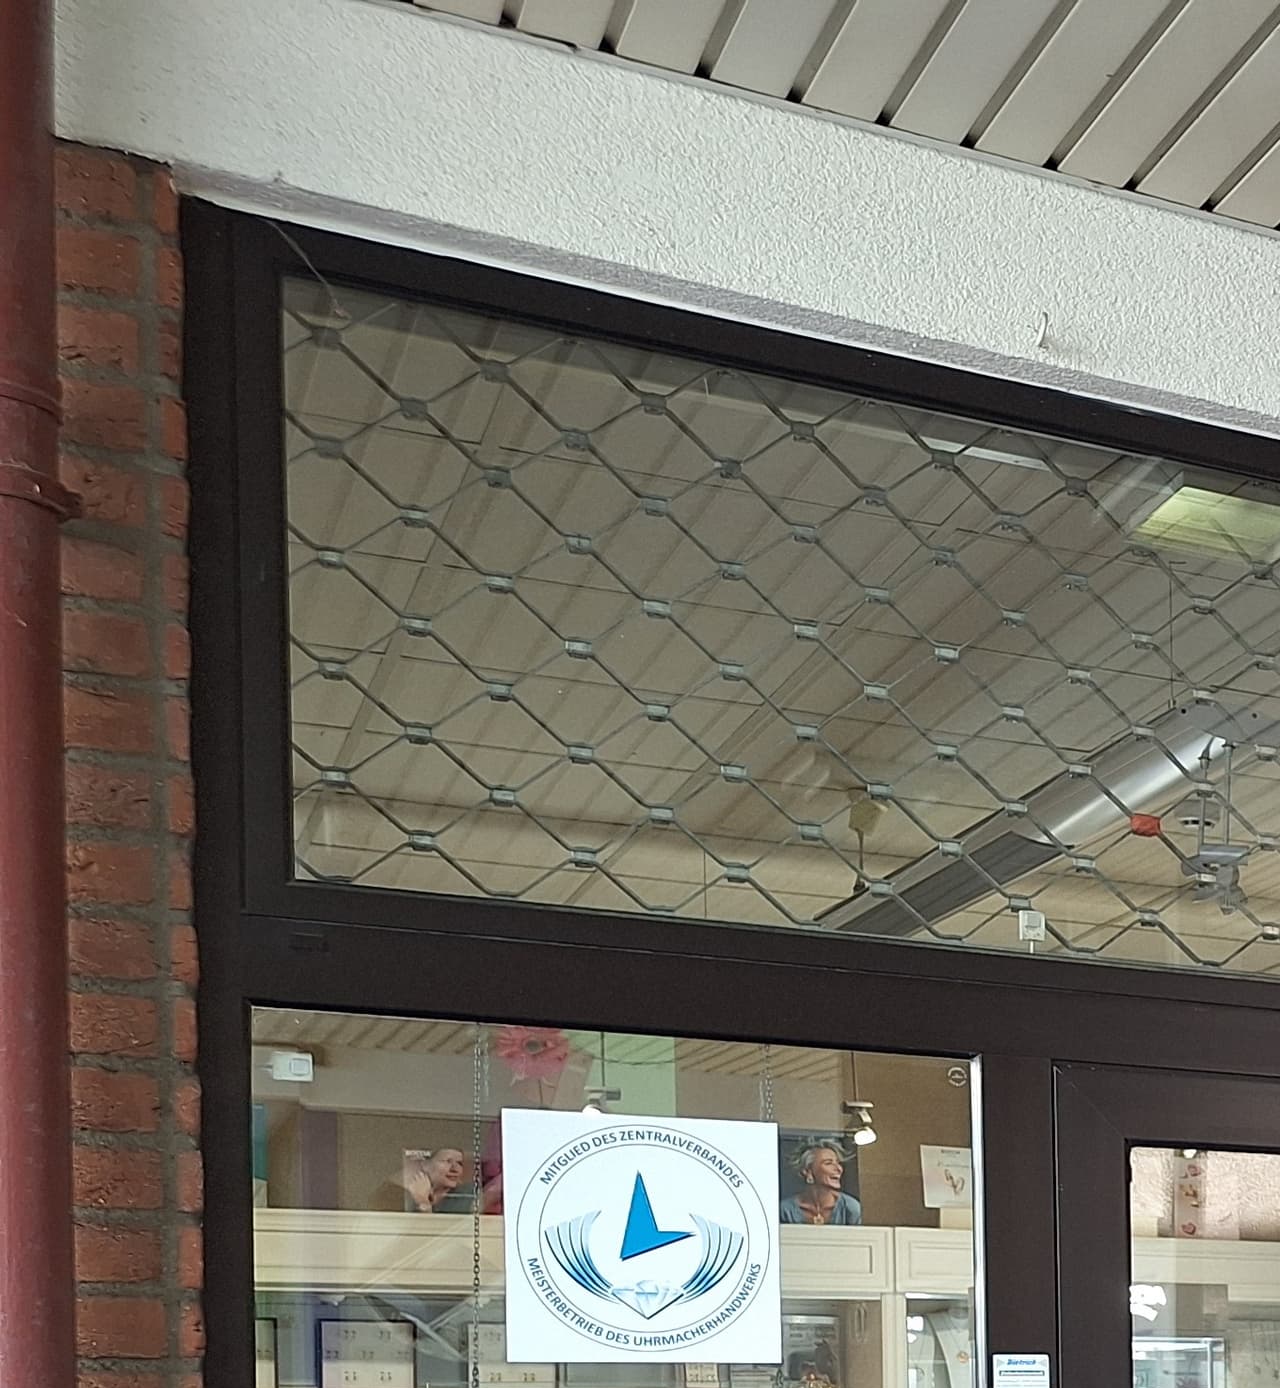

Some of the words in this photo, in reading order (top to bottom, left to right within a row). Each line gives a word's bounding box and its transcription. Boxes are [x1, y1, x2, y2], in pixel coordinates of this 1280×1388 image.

[539, 1140, 592, 1185] MITGLIED
[591, 1131, 617, 1148] DES
[619, 1130, 744, 1189] ZENTRALVERBANDES
[527, 1257, 604, 1337] MEISTERBETRIEB
[605, 1330, 630, 1346] DES
[633, 1262, 761, 1347] UHRMACHERHANDWERKS
